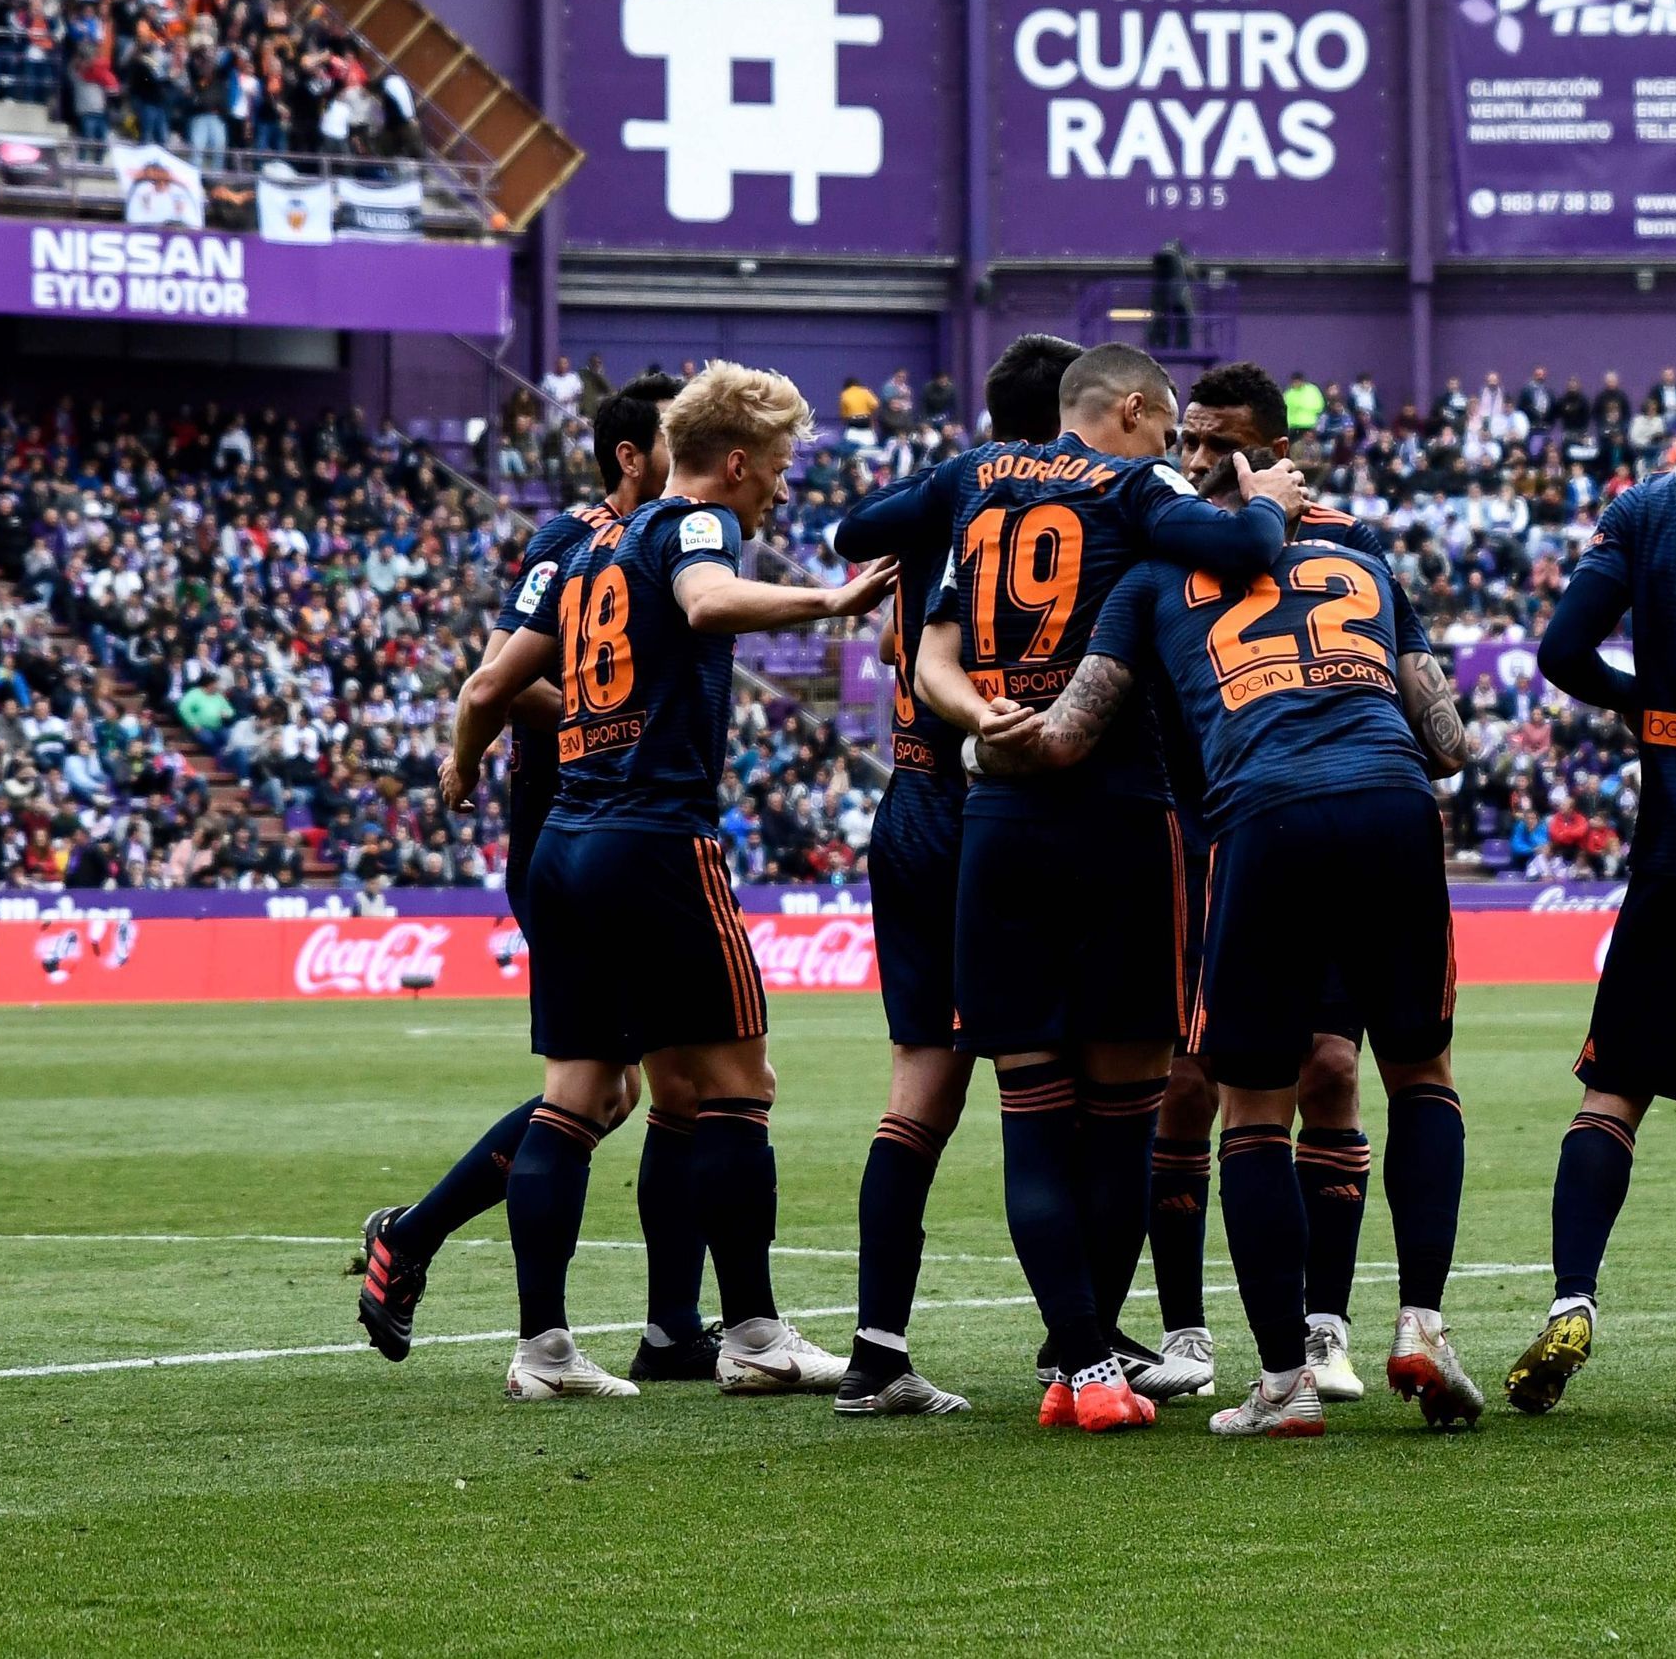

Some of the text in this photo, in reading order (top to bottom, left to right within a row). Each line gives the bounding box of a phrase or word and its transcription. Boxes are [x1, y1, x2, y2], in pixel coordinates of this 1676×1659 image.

[1014, 8, 1369, 92] CUATRO
[1048, 98, 1337, 180] RAYAS
[1147, 186, 1227, 208] 1935
[30, 227, 246, 280] NISSAN
[30, 273, 248, 319] EYLO MOTOR
[977, 454, 1089, 491] RODRGO
[961, 503, 1084, 663] 19
[558, 563, 633, 722] 18
[1184, 556, 1388, 683] 22
[1228, 662, 1389, 701] beIN SPORTS
[559, 719, 642, 756] eIN SPORTS
